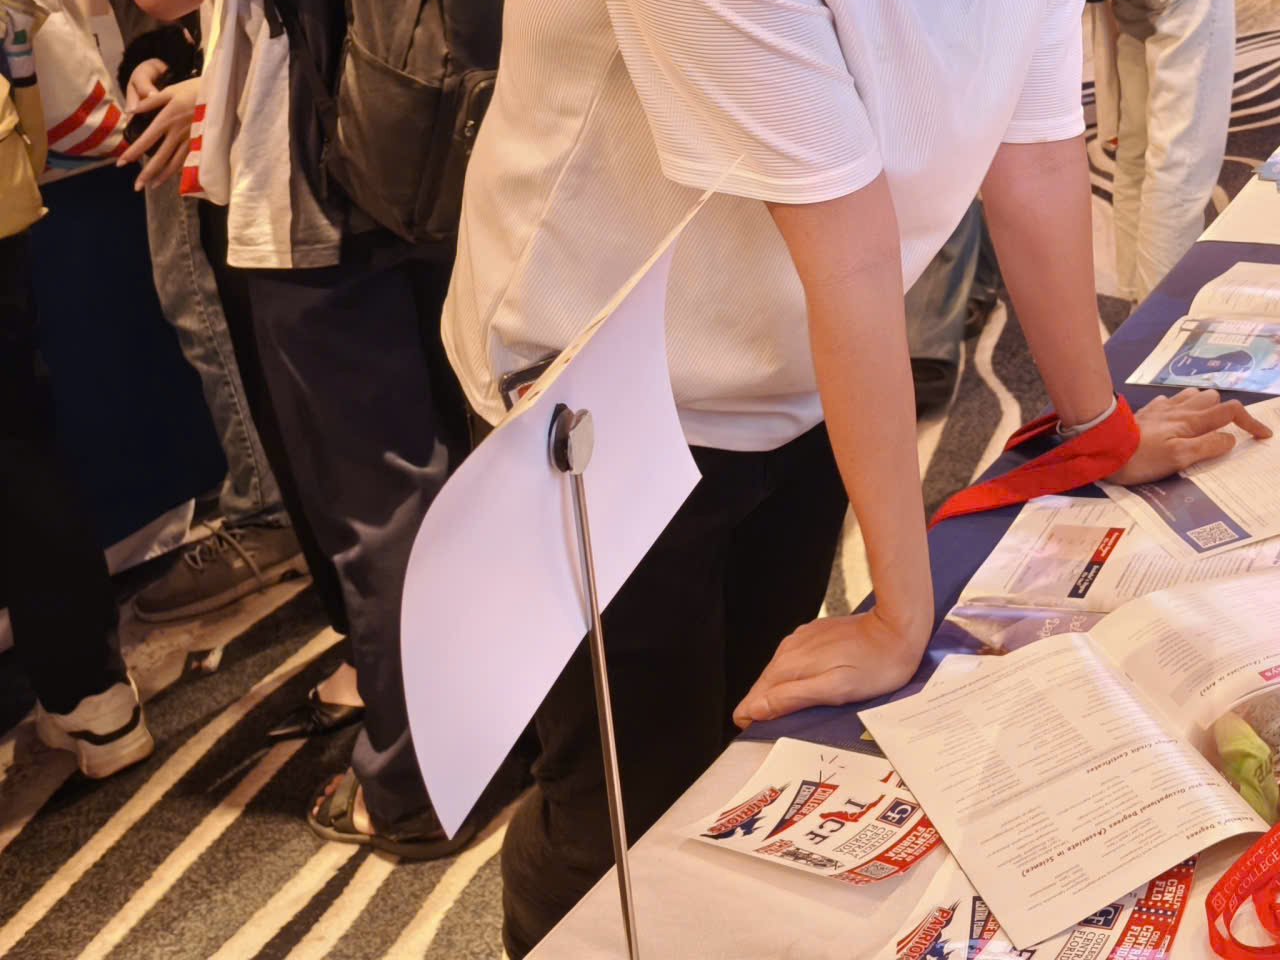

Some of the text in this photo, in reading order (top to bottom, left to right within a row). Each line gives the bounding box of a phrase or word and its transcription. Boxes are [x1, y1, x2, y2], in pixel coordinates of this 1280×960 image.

[1130, 743, 1152, 754] Credit
[1086, 751, 1129, 774] Certificates
[707, 785, 781, 834] PATRIOTS
[1139, 788, 1186, 812] Occupational
[886, 804, 912, 823] CF
[1108, 810, 1139, 830] Degrees
[832, 823, 879, 855] FLORIDA
[843, 826, 887, 856] CENTRAL
[861, 829, 894, 853] COLLEGE
[884, 826, 927, 857] FLORIDA
[1066, 828, 1107, 853] (Associate
[1185, 823, 1216, 840] Degrees
[890, 827, 937, 861] CENTRAL
[1056, 850, 1066, 858] in
[1021, 854, 1055, 878] Science)
[1091, 906, 1115, 926] CF
[1060, 930, 1085, 960] FLORID
[1085, 933, 1106, 960] COLLEG
[1128, 925, 1155, 960] CENTRA
